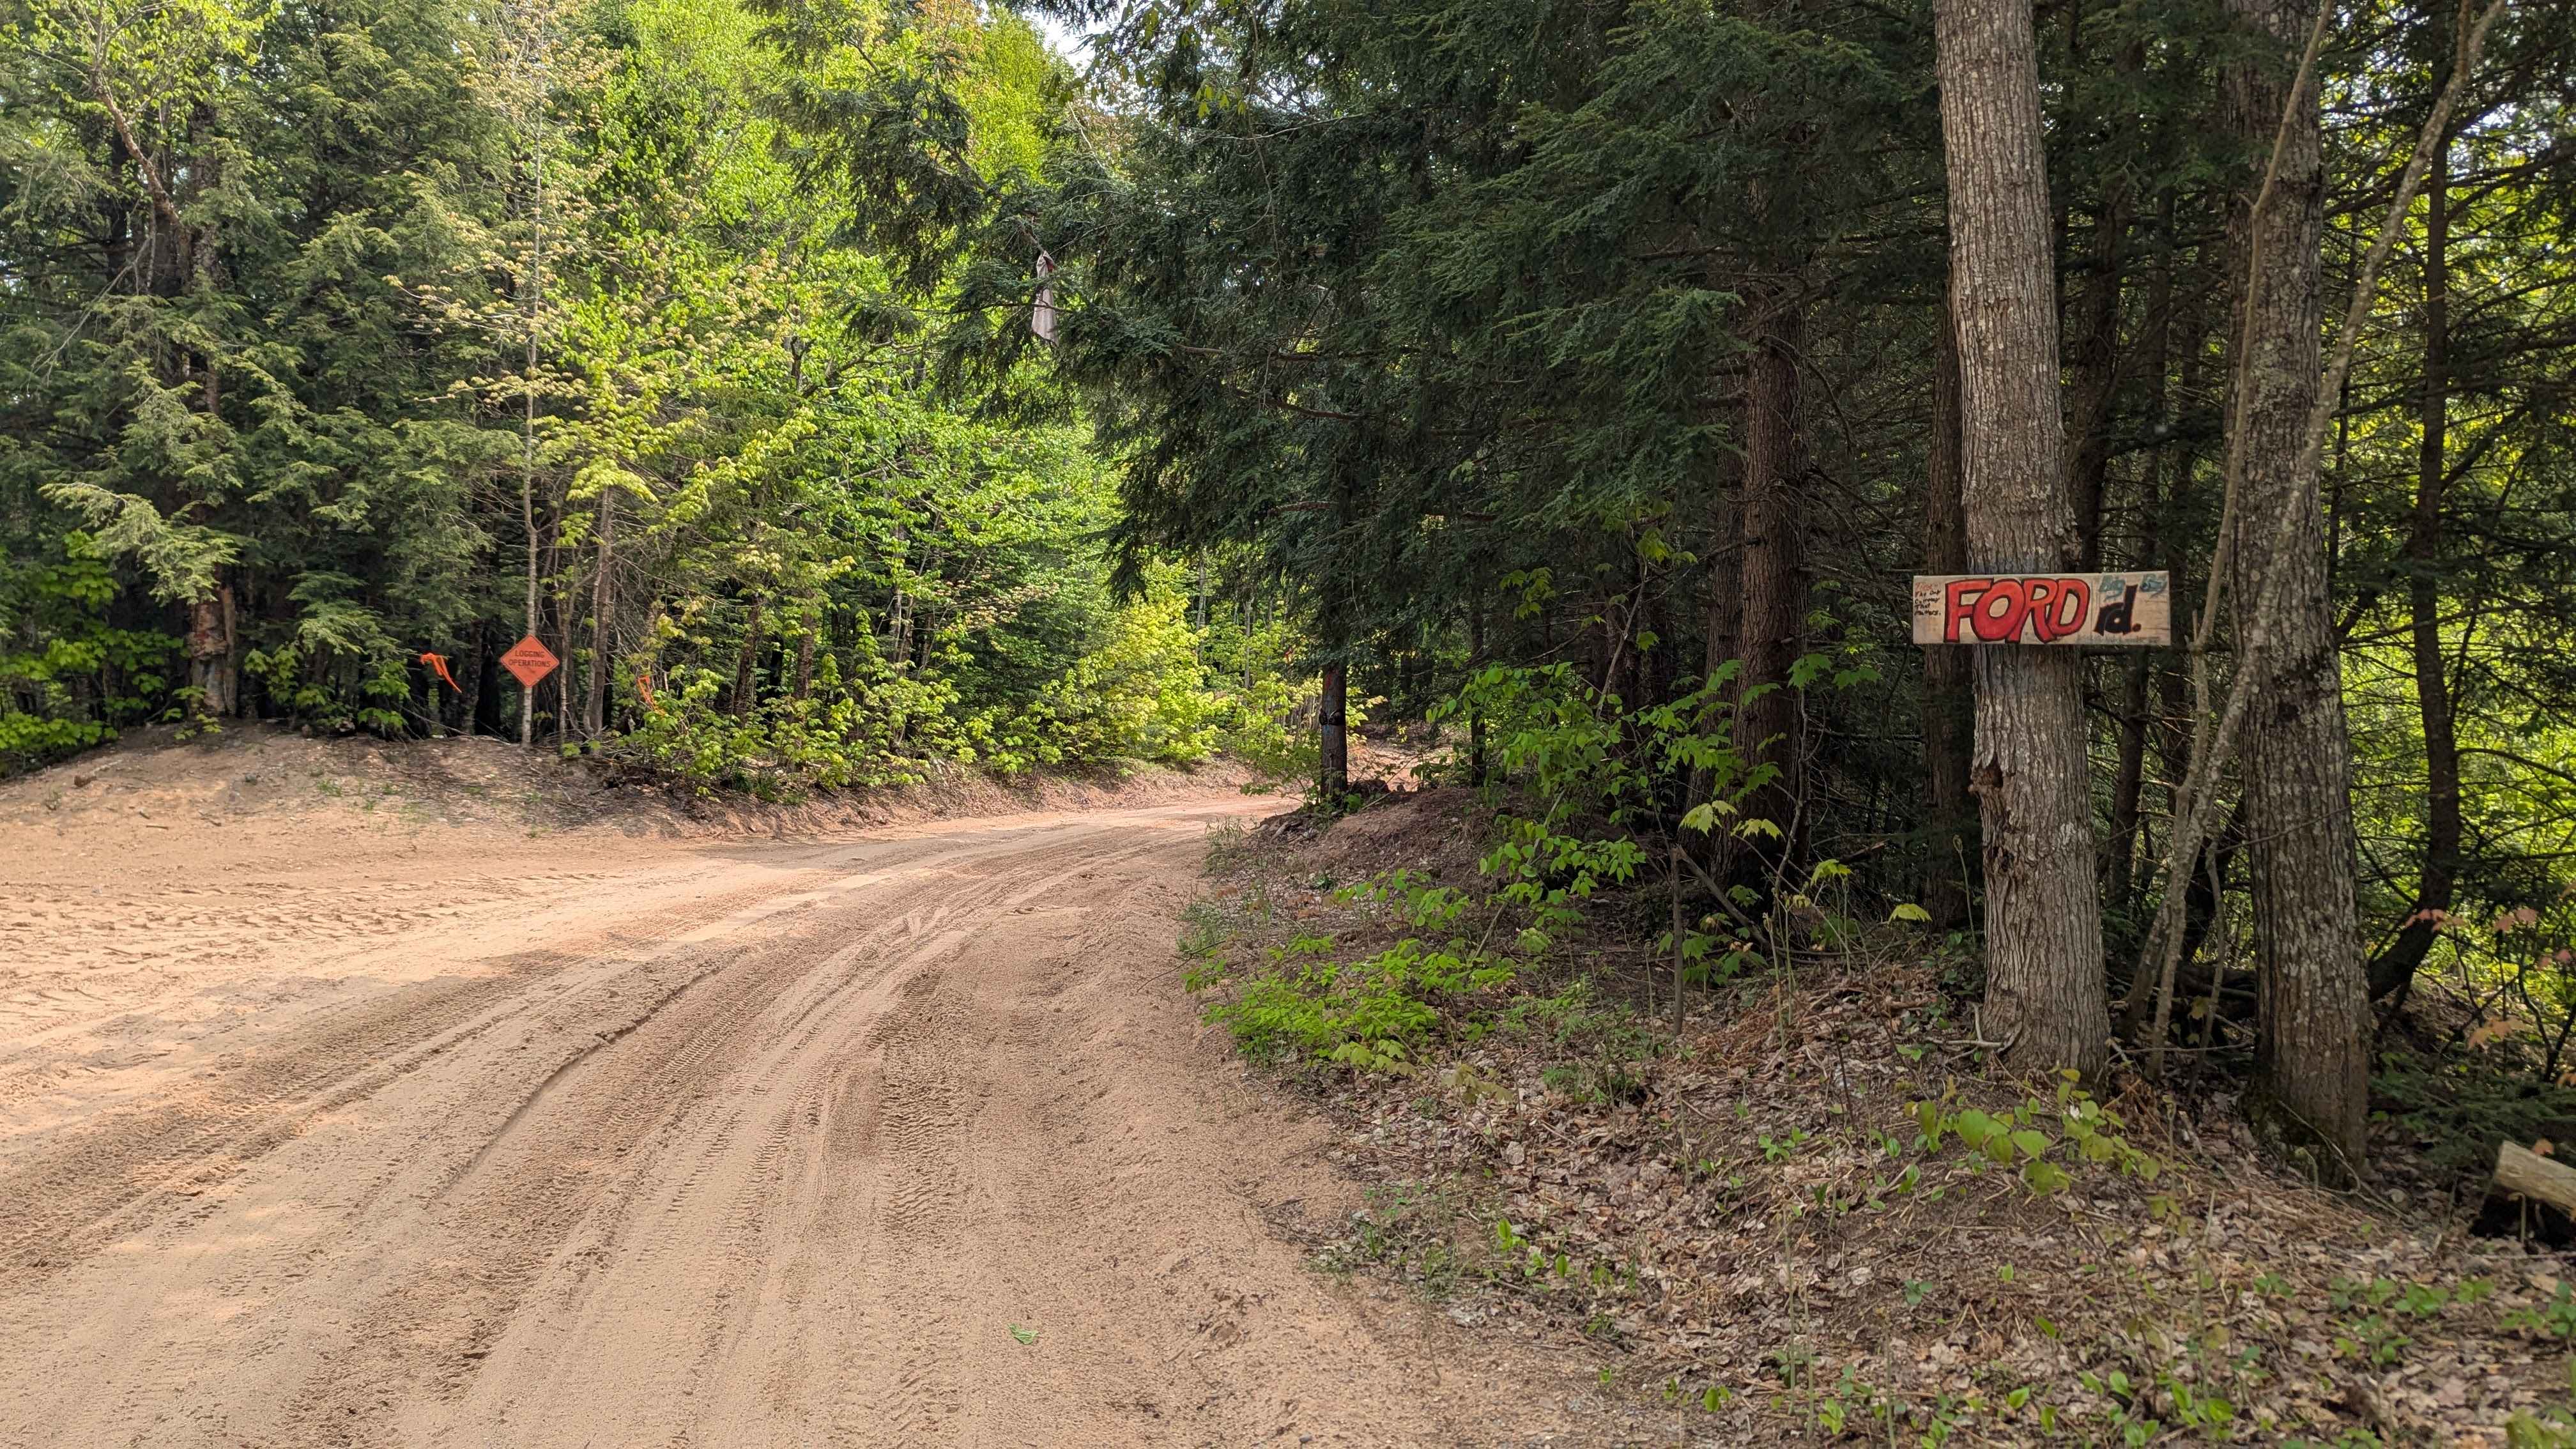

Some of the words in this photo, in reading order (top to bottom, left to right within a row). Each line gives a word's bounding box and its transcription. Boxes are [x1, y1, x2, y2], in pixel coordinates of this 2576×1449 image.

[1943, 578, 2090, 643] FORD
[514, 650, 545, 658] LOGGING
[508, 659, 551, 668] OPERATIONS
